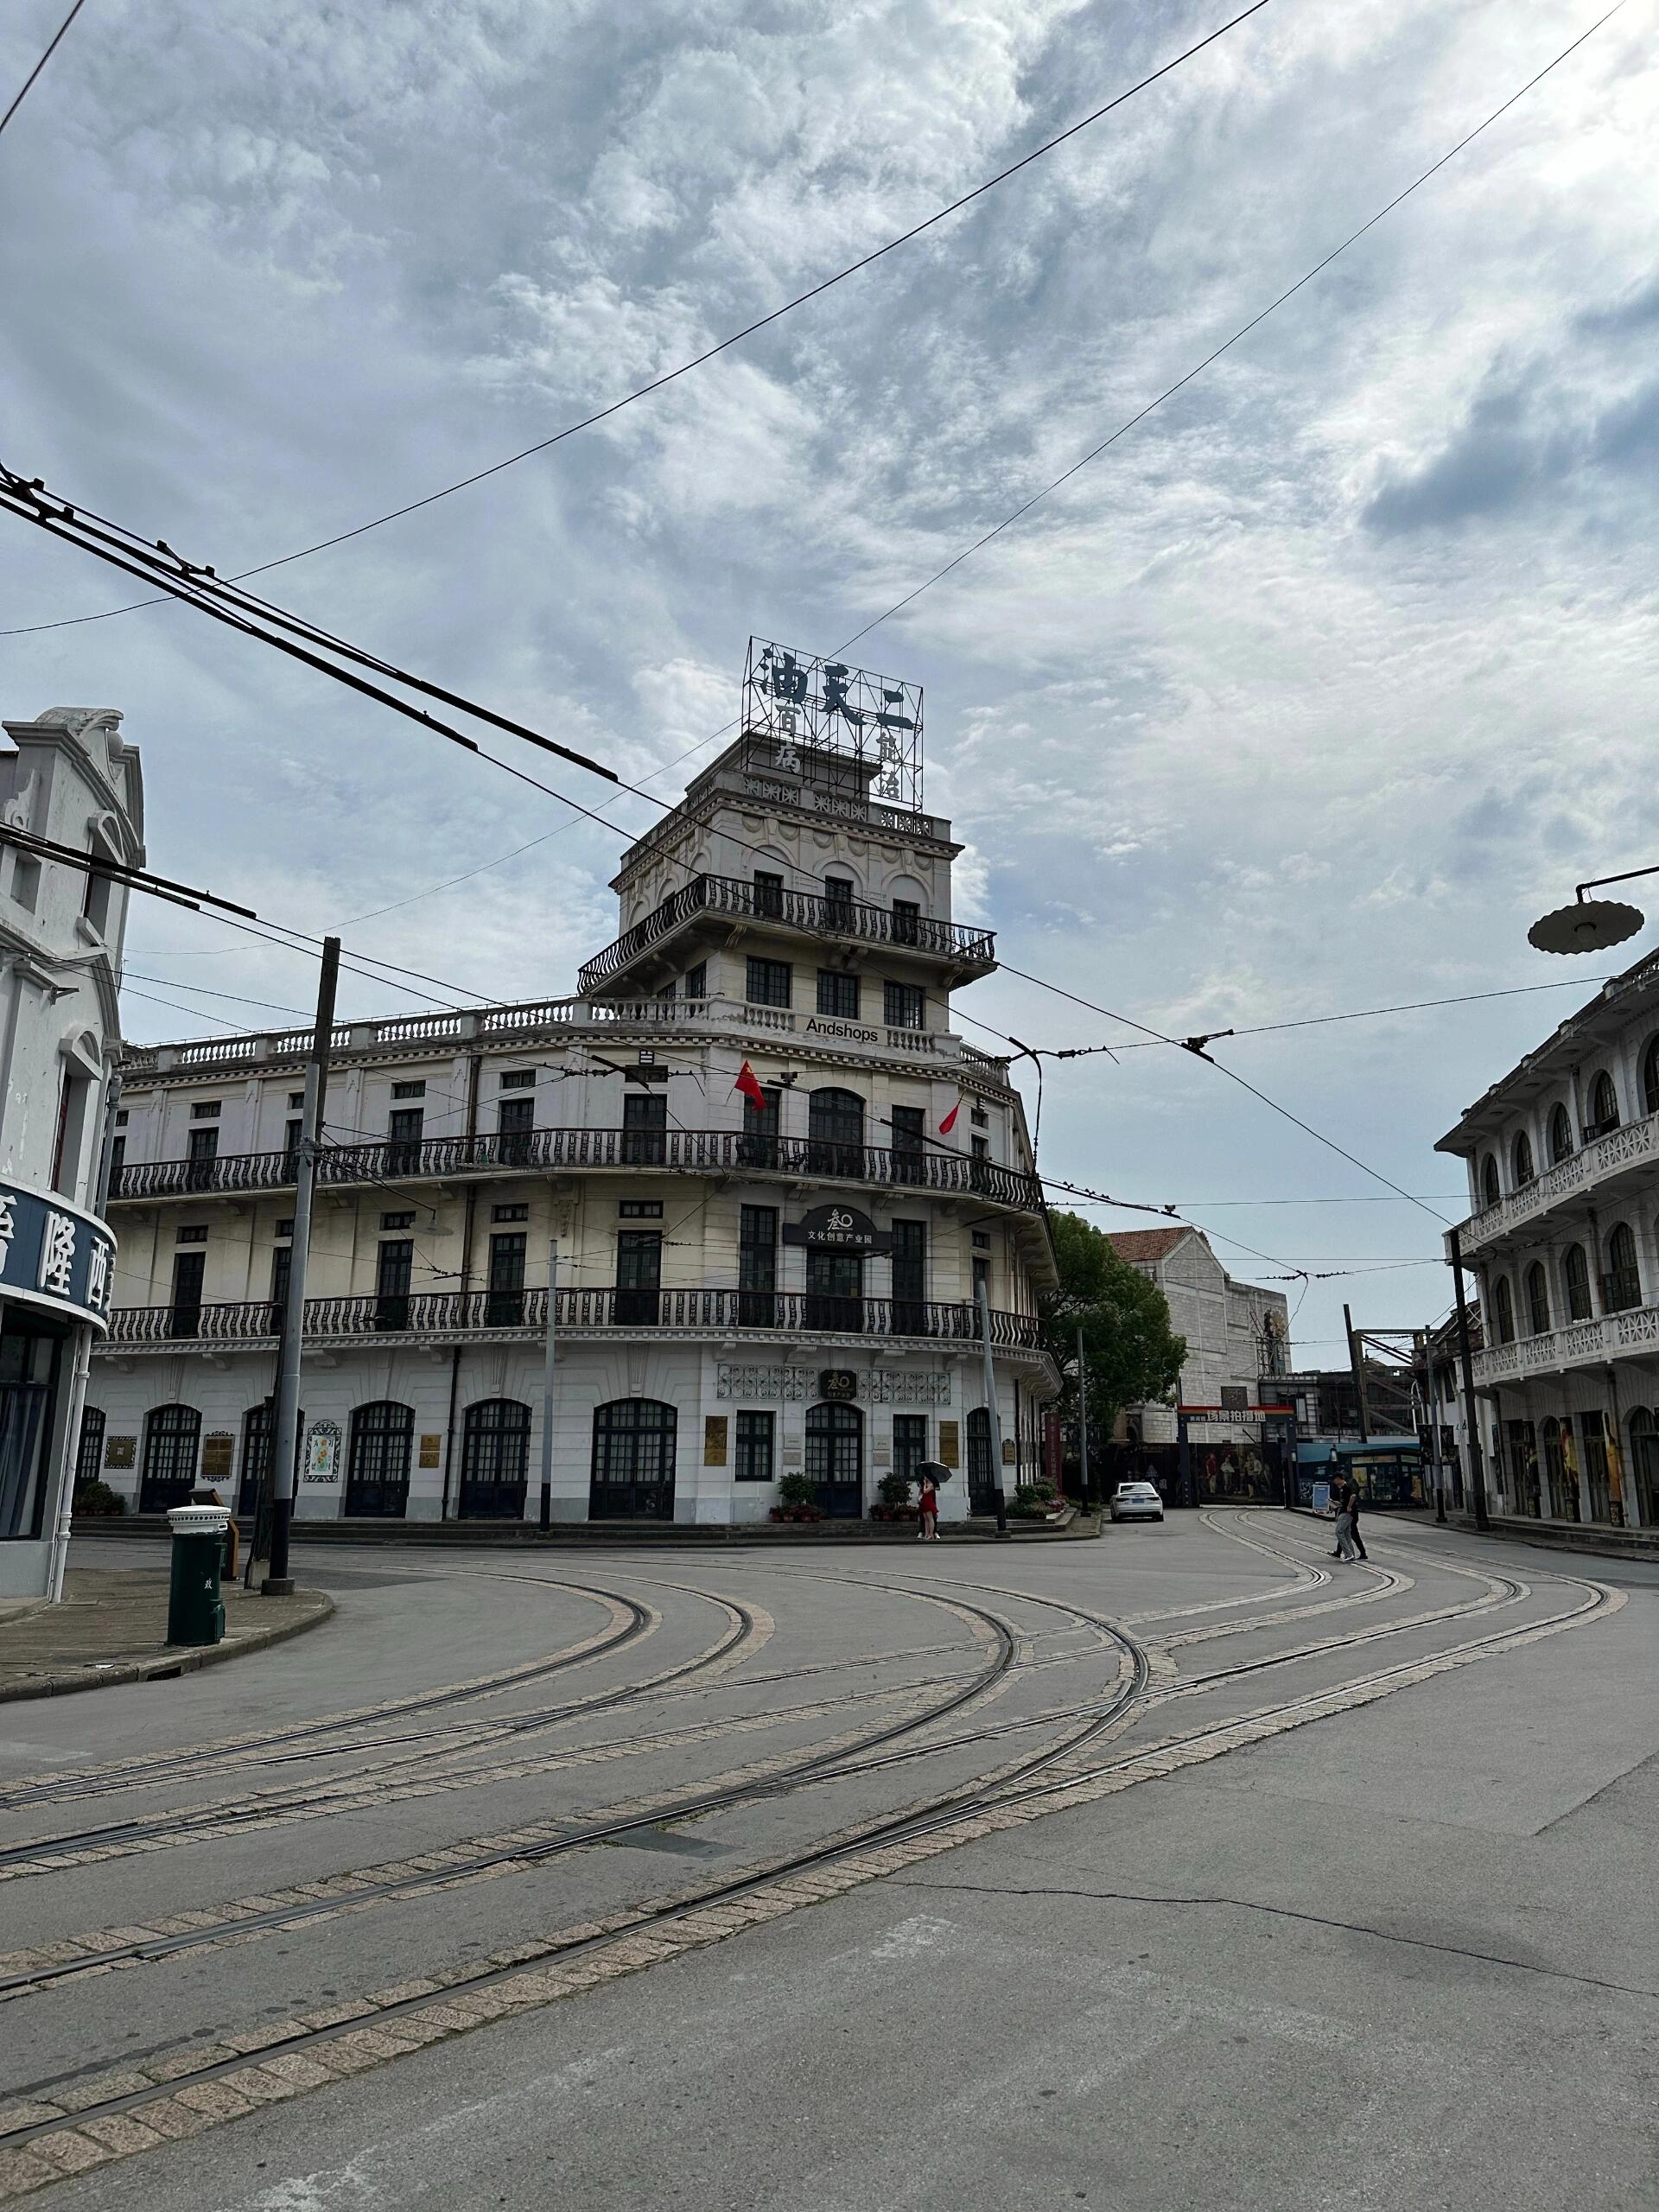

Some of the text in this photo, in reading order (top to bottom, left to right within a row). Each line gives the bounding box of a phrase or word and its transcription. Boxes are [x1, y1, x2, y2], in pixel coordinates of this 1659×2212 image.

[806, 1018, 879, 1042] Andshops
[808, 1230, 873, 1245] 文化创意产业园
